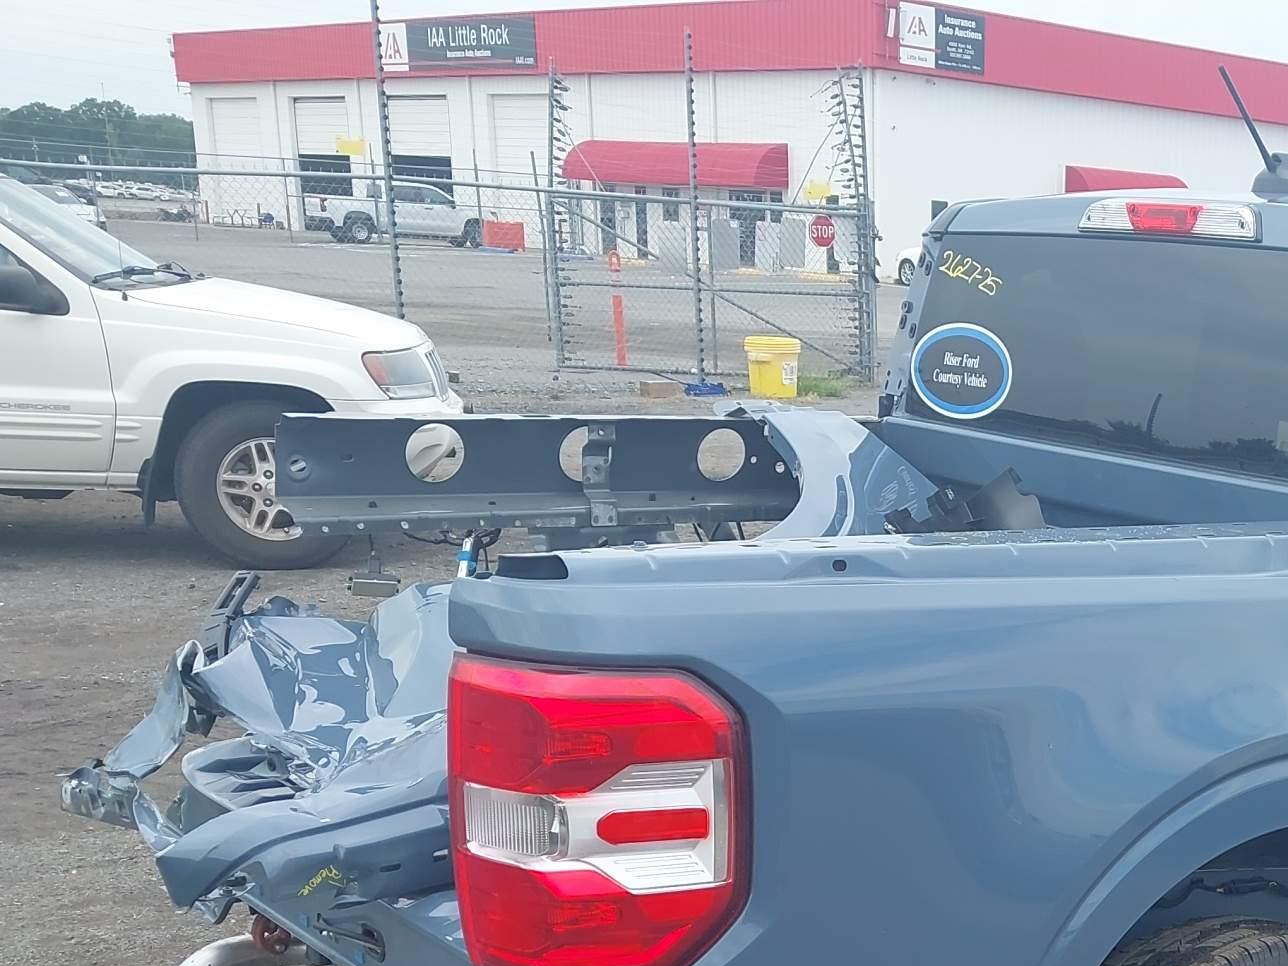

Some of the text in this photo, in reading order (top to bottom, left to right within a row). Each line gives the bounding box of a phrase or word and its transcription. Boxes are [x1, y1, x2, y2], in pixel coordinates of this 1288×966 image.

[944, 14, 976, 28] Insurance
[427, 23, 510, 47] IAA Little Rock
[938, 24, 983, 40] Auto Auctions
[811, 225, 834, 239] STOP
[943, 351, 980, 369] Riser Ford
[933, 368, 988, 388] Courtesy Vehicle
